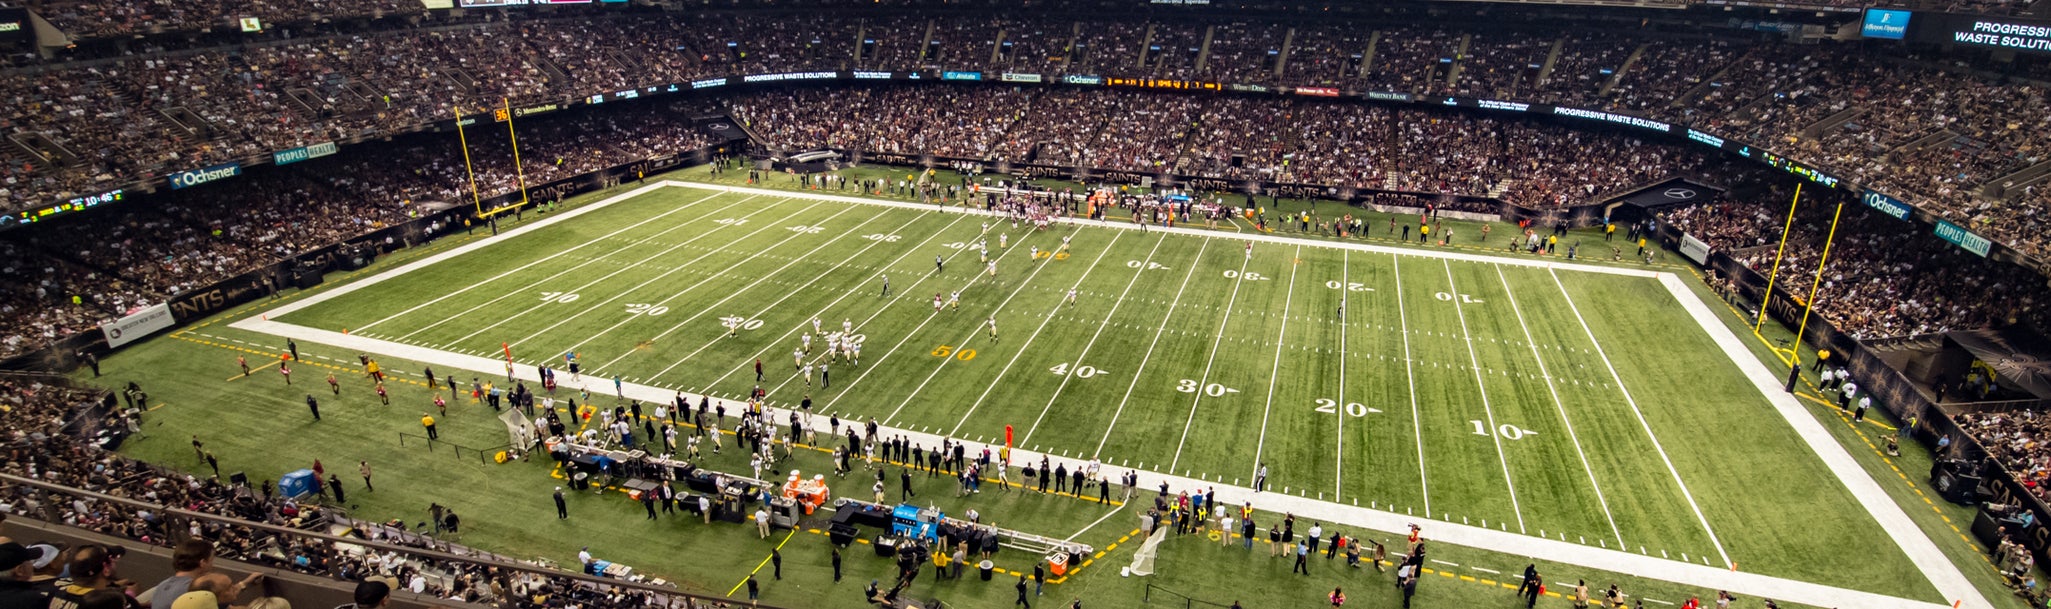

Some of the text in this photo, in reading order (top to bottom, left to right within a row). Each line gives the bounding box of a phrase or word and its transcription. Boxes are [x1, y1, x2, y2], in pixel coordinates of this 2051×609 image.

[1955, 31, 1999, 45] WASTE
[1973, 21, 2051, 38] PROGRESSI
[744, 73, 784, 82] PROGRESSIVE
[784, 72, 804, 80] WASTE
[1069, 75, 1098, 84] Ochsner
[495, 109, 508, 121] 36
[1554, 106, 1670, 132] PROGRESSIVE WASTE SOLUTIONS
[276, 149, 308, 163] PEOPLES
[876, 154, 907, 164] SAINTS
[183, 166, 236, 186] Ochsner
[1025, 166, 1060, 177] SAINTS
[1105, 172, 1141, 184] SAINTS
[532, 182, 575, 200] SAINTS
[1191, 178, 1228, 190] SAINTS
[85, 192, 113, 207] 10:46
[1869, 193, 1906, 219] Ochsner
[1936, 222, 1989, 255] PEOPLES HEALTH
[931, 345, 977, 362] 50
[1049, 362, 1096, 379] 40
[1176, 379, 1226, 397] 30
[1314, 398, 1368, 418] 20
[1469, 419, 1523, 441] 10
